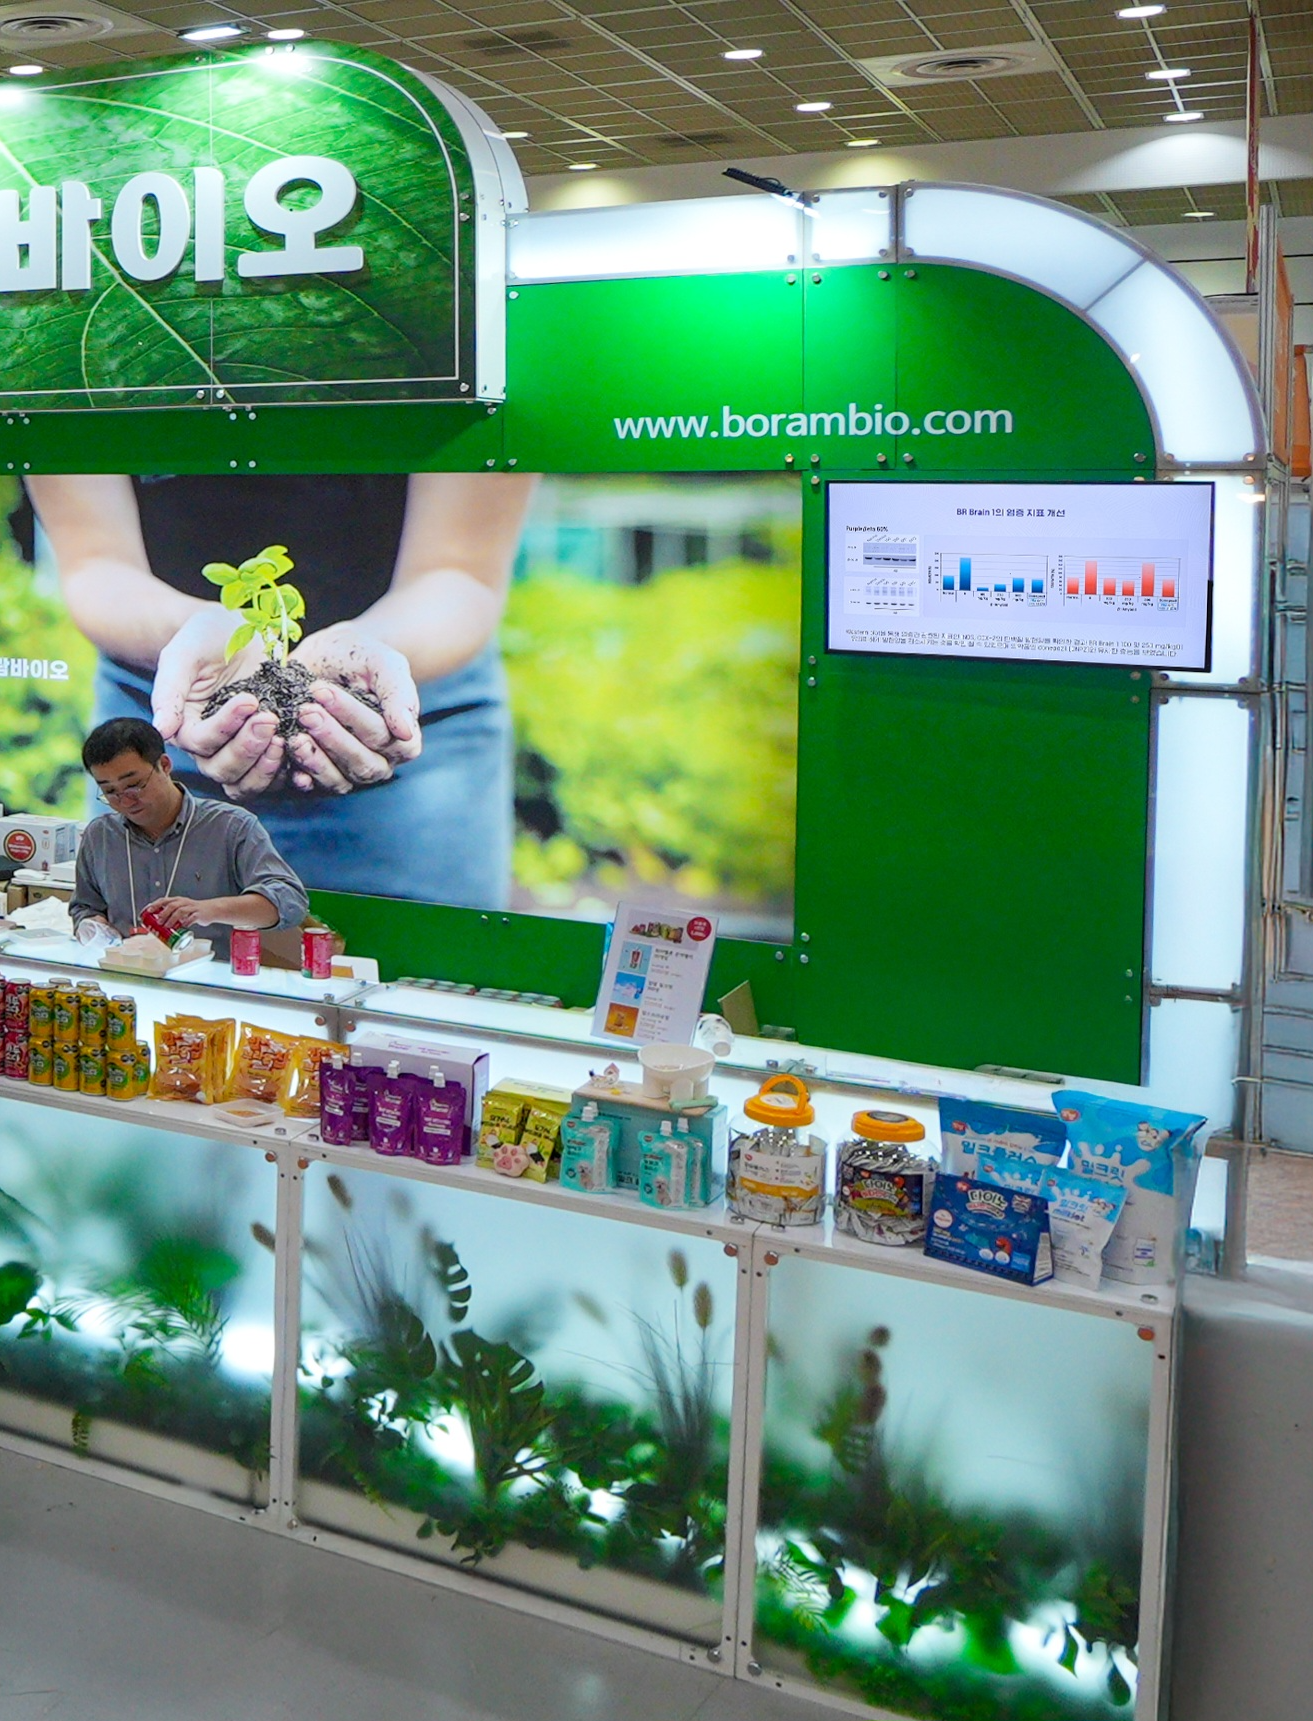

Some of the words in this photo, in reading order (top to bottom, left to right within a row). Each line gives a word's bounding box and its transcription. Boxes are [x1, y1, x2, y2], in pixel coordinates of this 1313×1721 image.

[614, 403, 1014, 439] www.borambio.com
[956, 508, 968, 516] BR
[969, 508, 990, 516] Brain
[1081, 1159, 1125, 1184] 밀크릿
